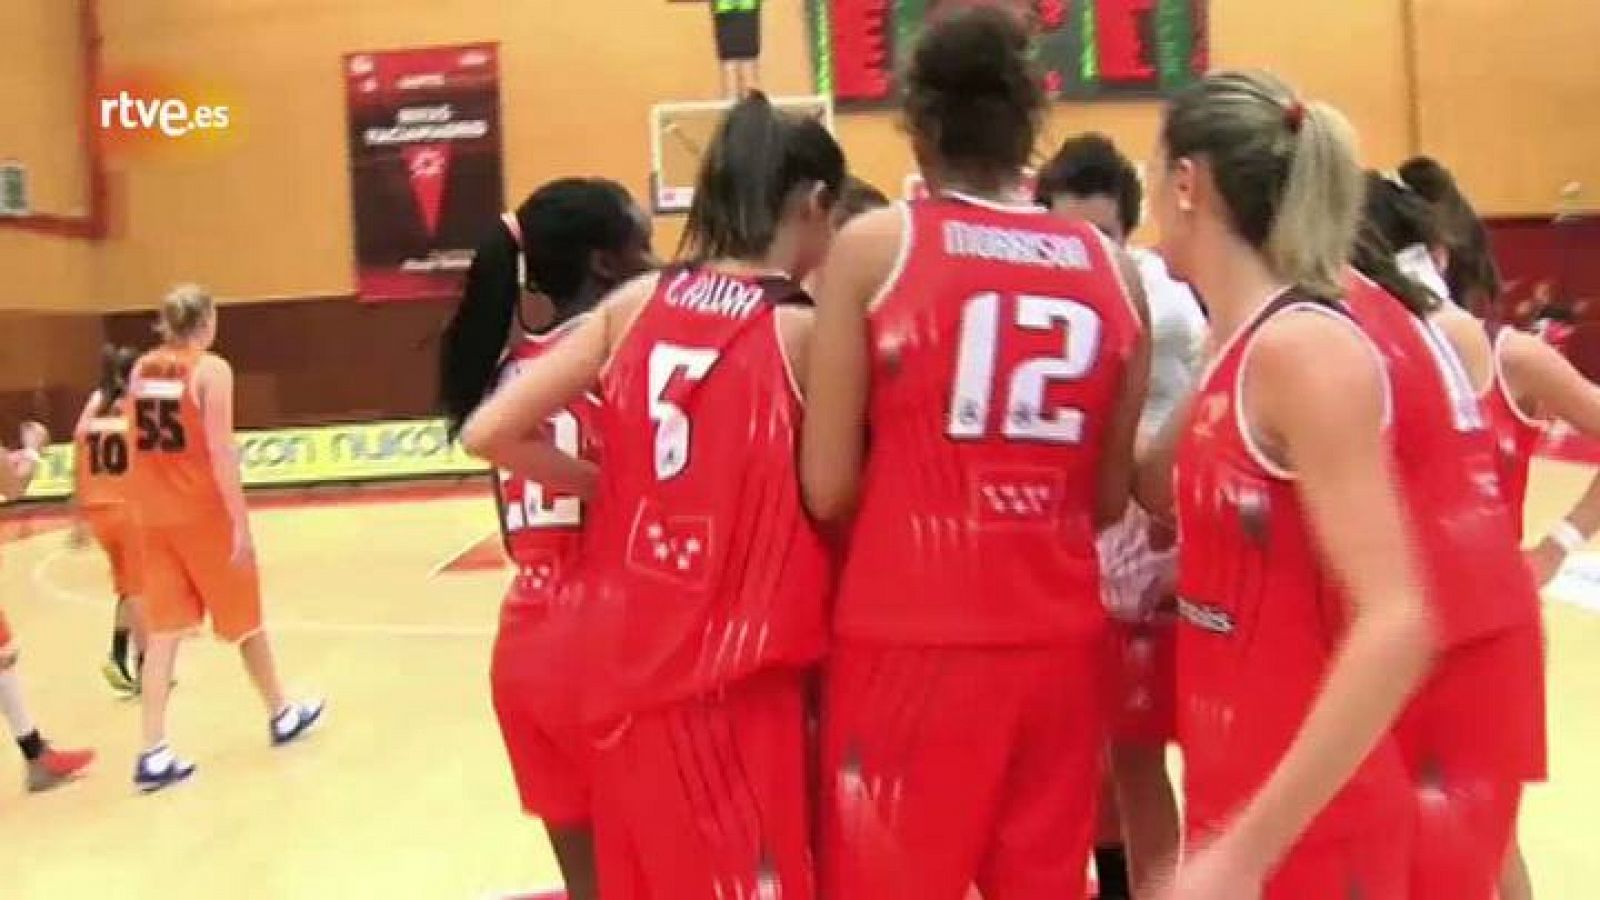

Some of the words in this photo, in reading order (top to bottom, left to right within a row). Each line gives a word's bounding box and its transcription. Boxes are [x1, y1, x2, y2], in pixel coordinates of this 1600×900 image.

[648, 341, 721, 482] 5
[946, 290, 1102, 443] 12
[86, 431, 129, 476] 10
[136, 399, 186, 452] 55
